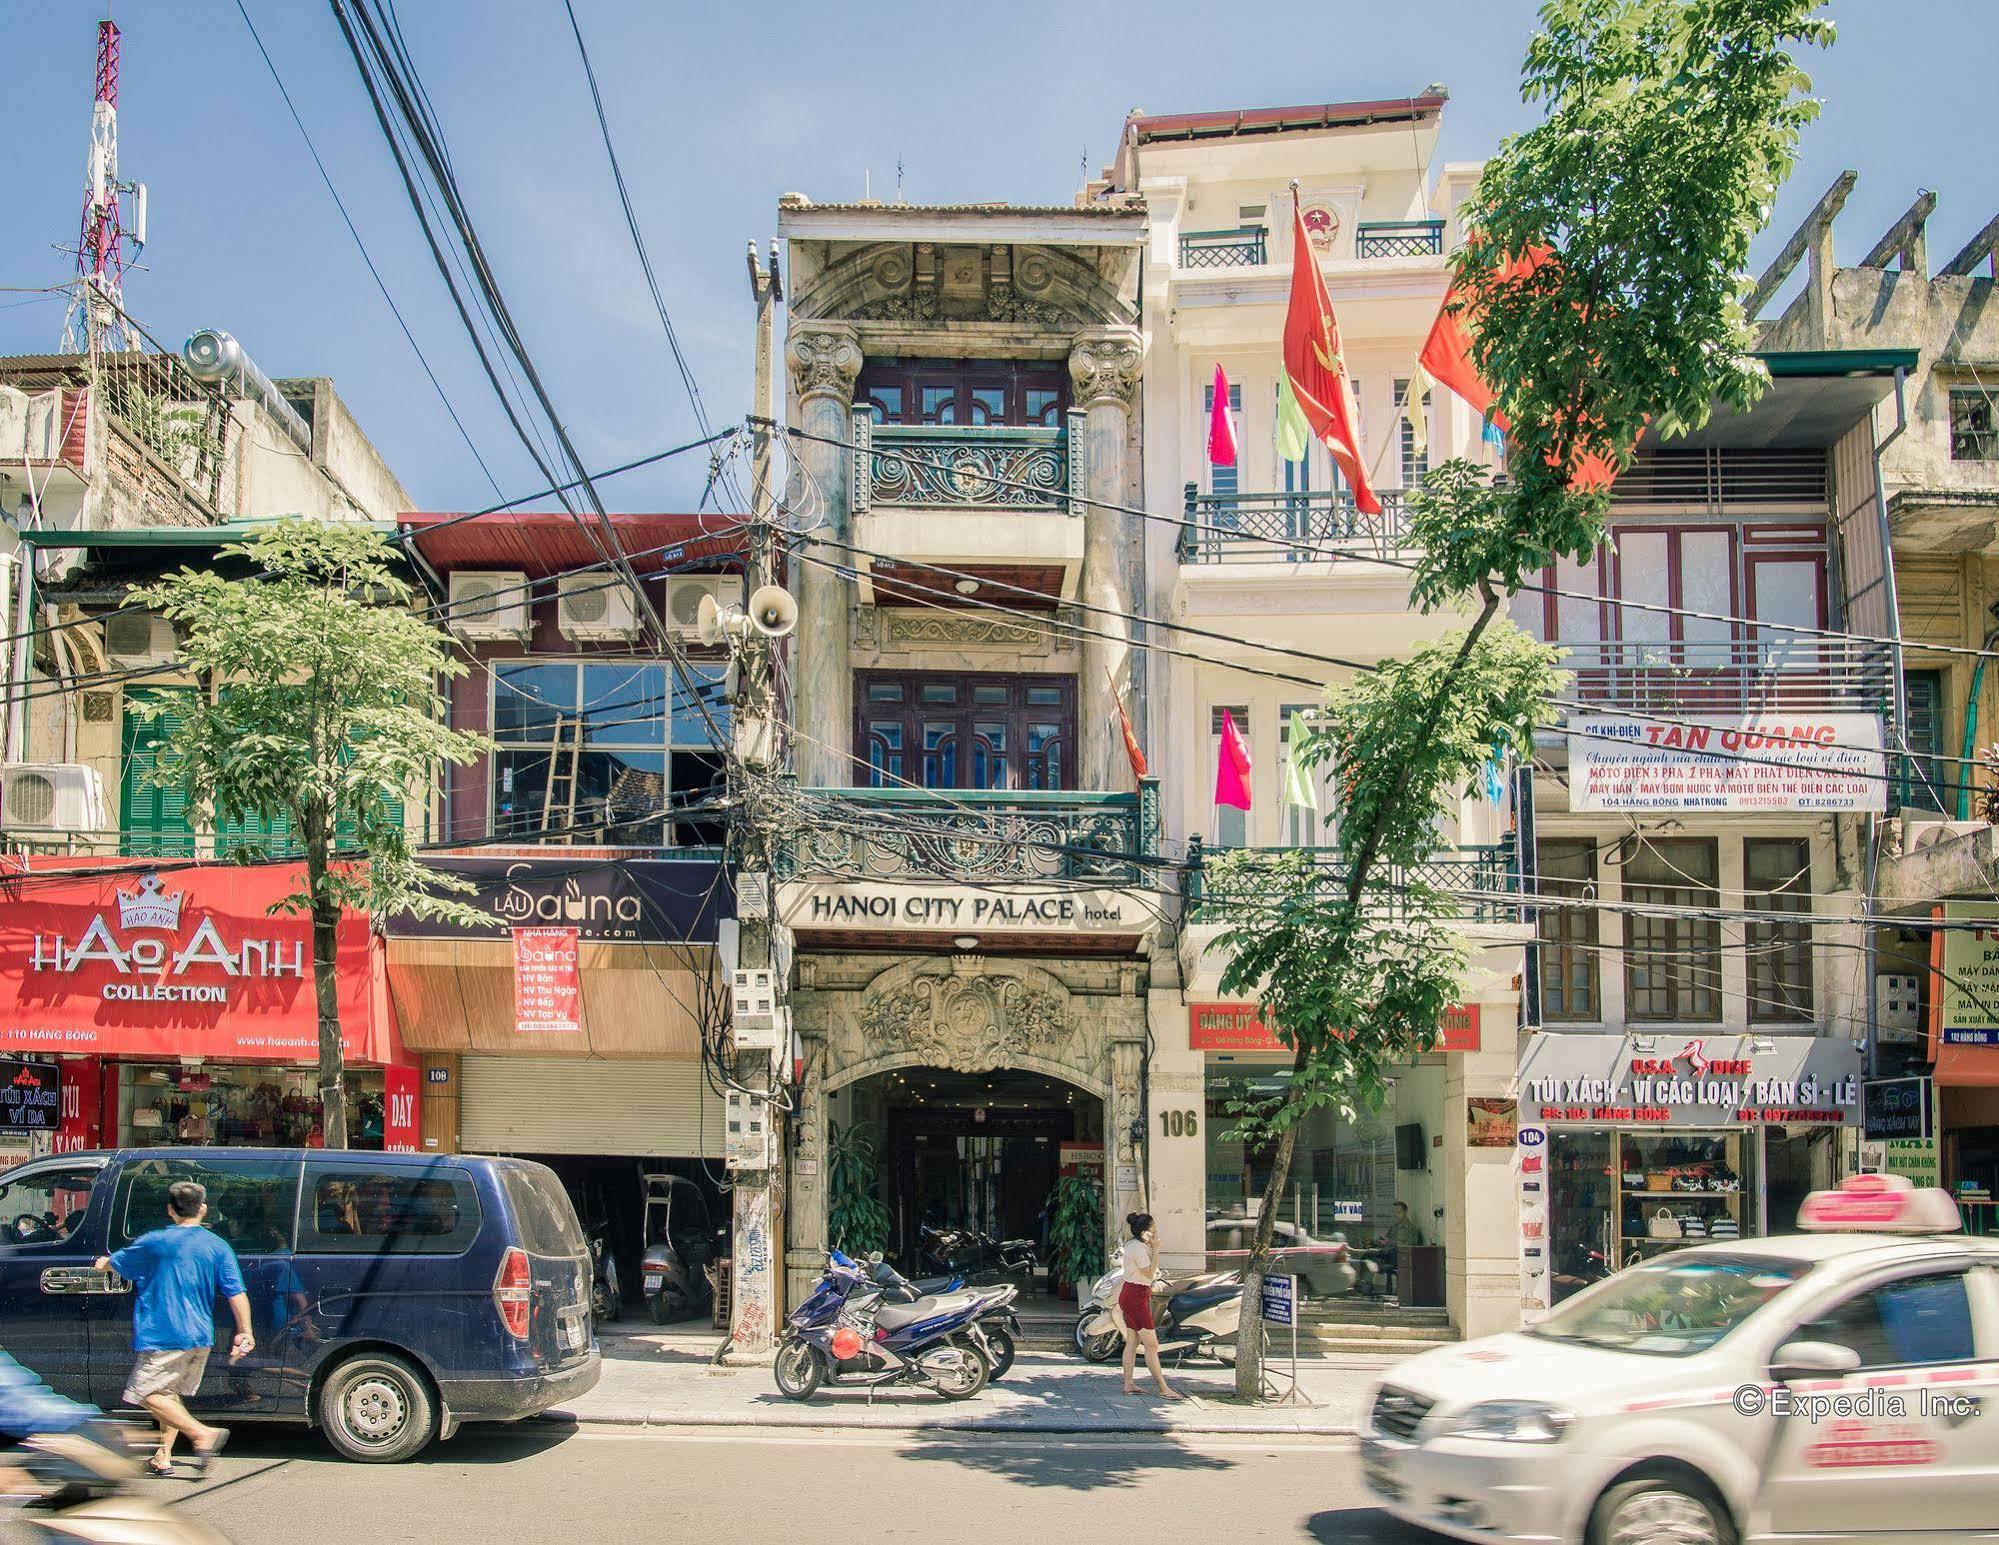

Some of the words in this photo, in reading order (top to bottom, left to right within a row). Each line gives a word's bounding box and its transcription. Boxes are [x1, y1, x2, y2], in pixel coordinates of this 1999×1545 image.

[1721, 725, 1836, 752] QUANG
[1653, 767, 1659, 779] 3
[1662, 767, 1684, 779] PHA
[1602, 798, 1619, 806] 104
[505, 862, 642, 921] Sauna
[813, 895, 896, 918] HANOI
[905, 897, 963, 919] CITY
[975, 899, 1074, 920] PALACE
[1085, 906, 1122, 921] hotel
[126, 912, 148, 926] HAO
[150, 912, 173, 926] ANH
[103, 983, 226, 1002] COLLECTION
[7, 1029, 27, 1039] 110
[430, 1069, 447, 1081] 108
[1632, 1058, 1677, 1075] U.S.A.
[62, 1076, 80, 1118] TÚI
[1531, 1074, 1562, 1103] TÚI
[1566, 1074, 1616, 1103] XÁCH
[1633, 1075, 1651, 1103] VÍ
[1656, 1075, 1693, 1104] CÁC
[1697, 1081, 1738, 1109] LOẠI
[1756, 1077, 1794, 1105] BÁN
[1800, 1073, 1817, 1105] SỈ
[1835, 1073, 1856, 1105] LẺ
[391, 1086, 414, 1128] DÂY
[27, 1109, 46, 1124] DA
[1159, 1110, 1197, 1137] 106
[1522, 1131, 1540, 1143] 104
[1071, 1152, 1096, 1160] HSBC
